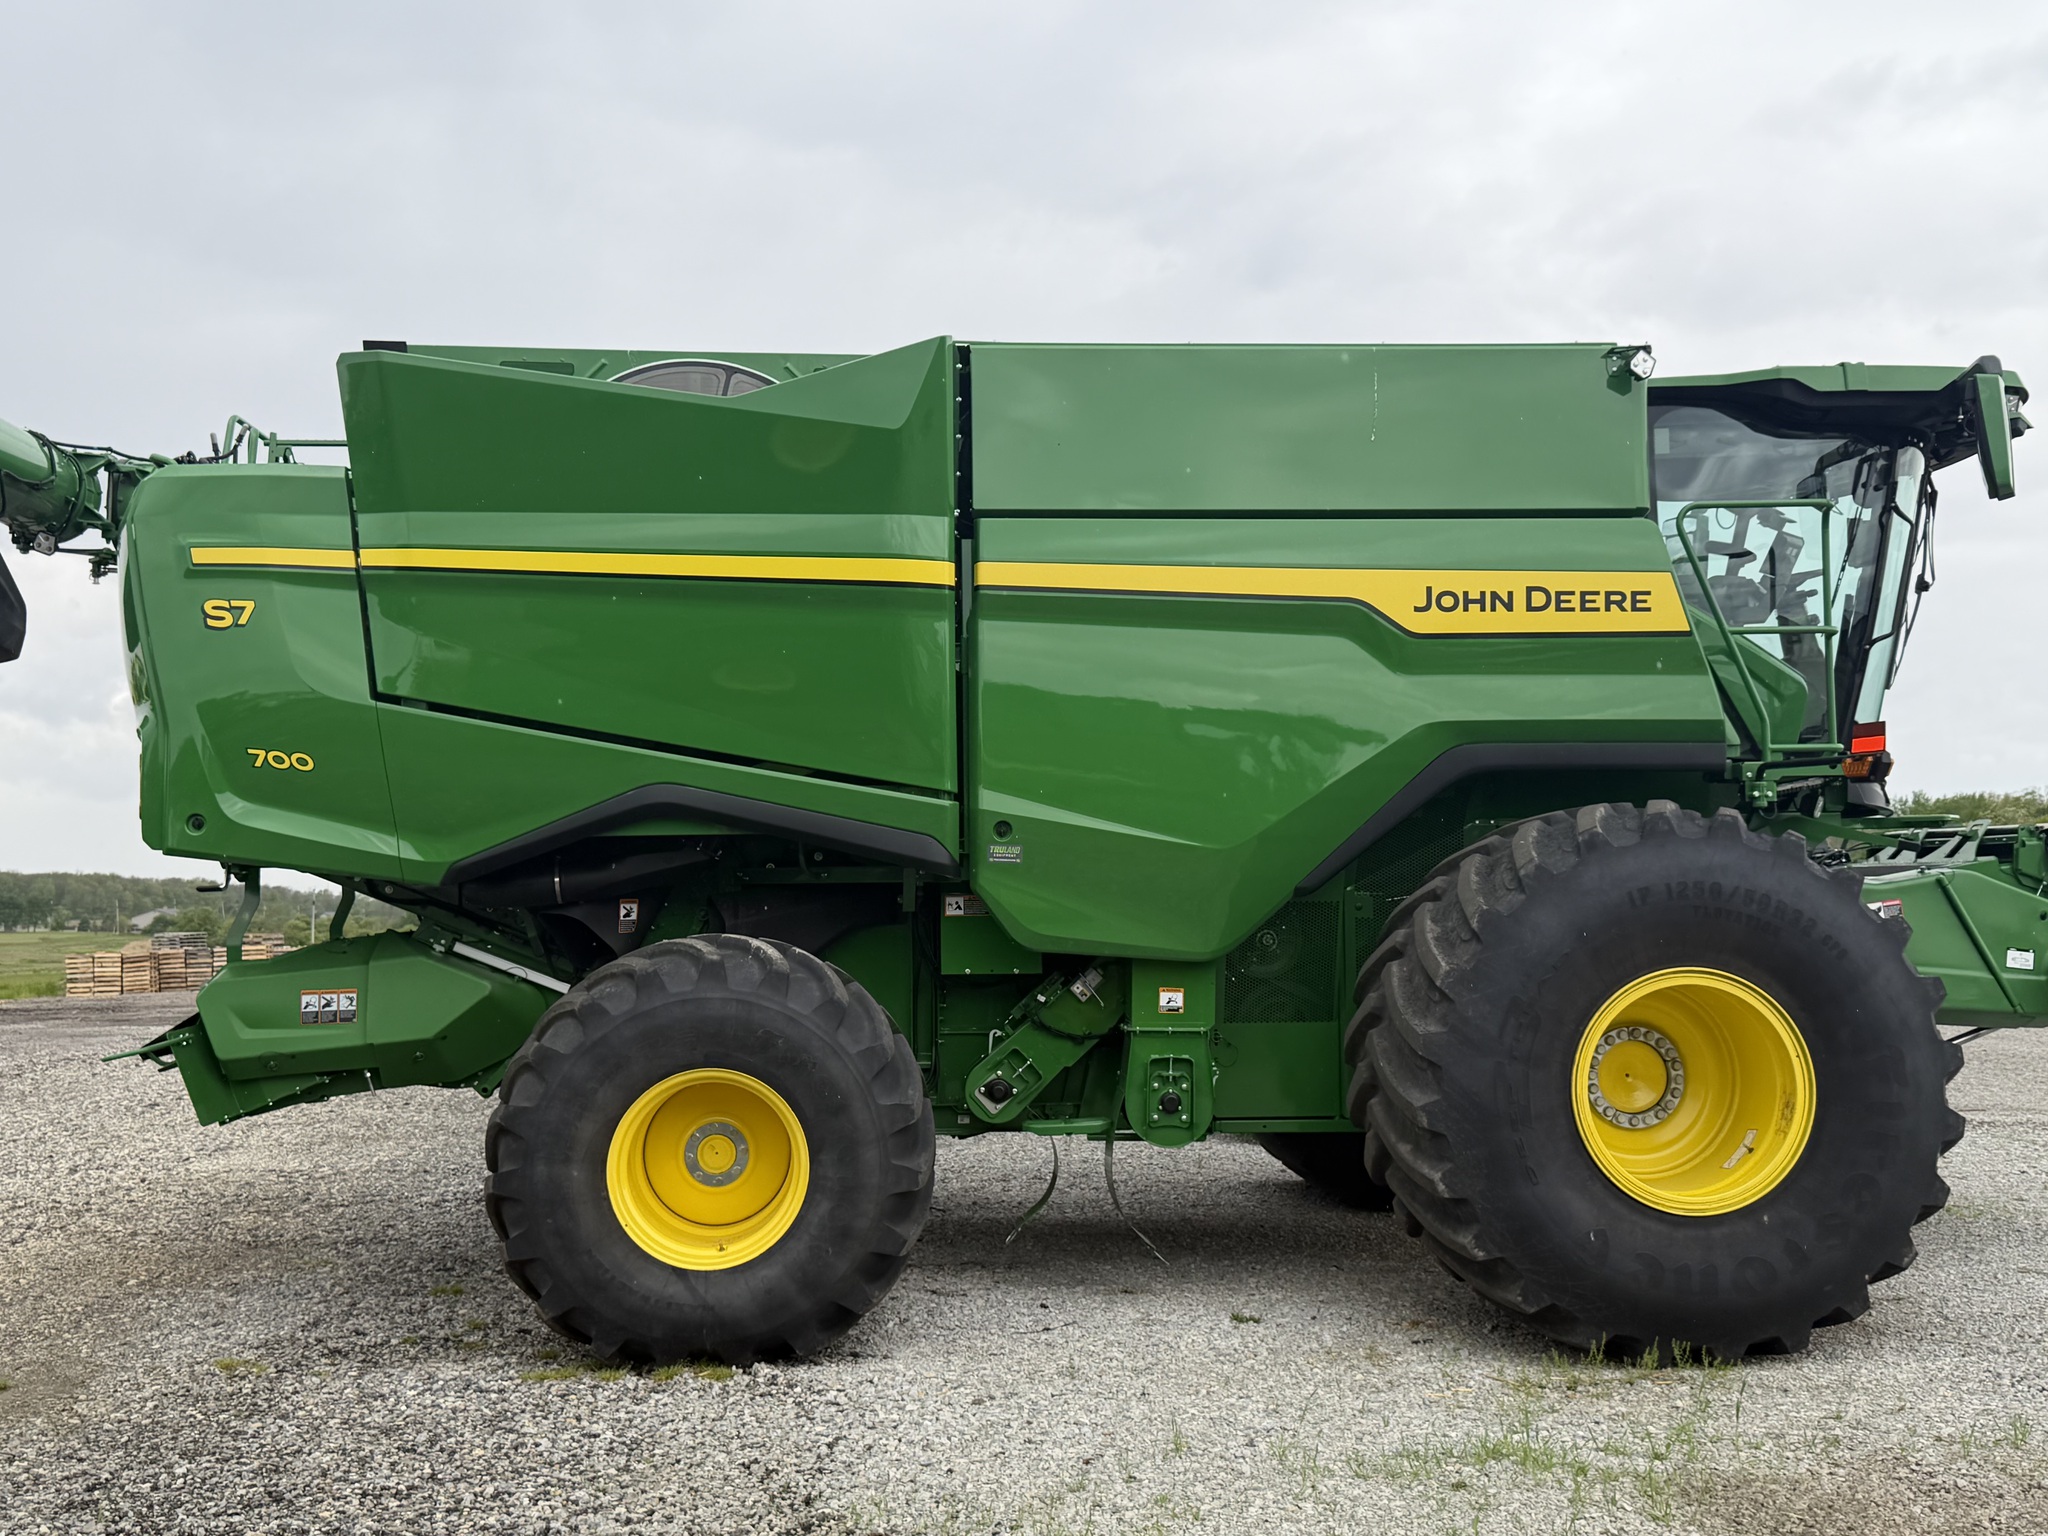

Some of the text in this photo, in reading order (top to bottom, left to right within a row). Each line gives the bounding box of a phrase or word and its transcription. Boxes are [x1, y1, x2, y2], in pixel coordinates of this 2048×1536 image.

[1413, 586, 1652, 613] JOHN DEERE
[202, 599, 257, 631] S7
[246, 748, 316, 772] 700
